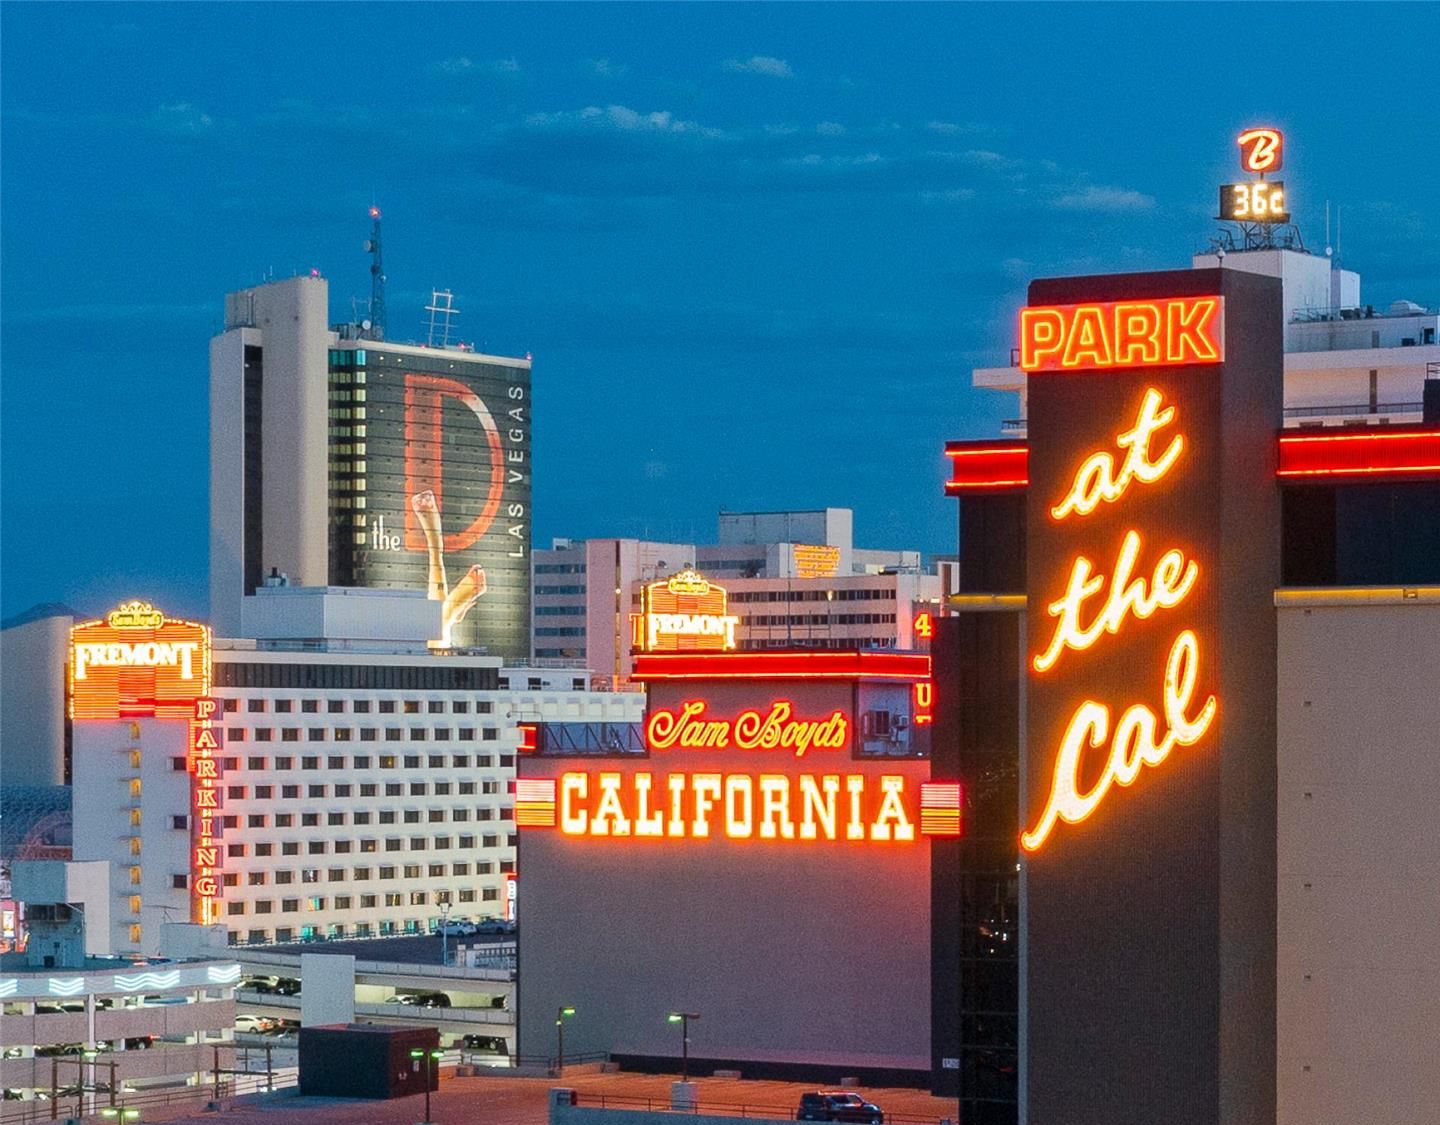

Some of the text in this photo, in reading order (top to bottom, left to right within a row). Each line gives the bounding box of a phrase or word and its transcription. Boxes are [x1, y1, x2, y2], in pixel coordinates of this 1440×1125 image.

[1237, 130, 1280, 170] B
[1021, 299, 1217, 369] PARK
[508, 385, 524, 558] LAS VEGAS
[1050, 386, 1184, 520] at
[371, 514, 401, 550] the
[648, 613, 740, 650] FREMONT
[914, 612, 932, 637] 4
[1033, 529, 1199, 672] the
[74, 642, 199, 680] FREMONT
[648, 702, 730, 750] Sam
[1021, 629, 1217, 851] Cal
[196, 700, 218, 896] PARKING
[561, 771, 915, 842] CALIFORNIA
